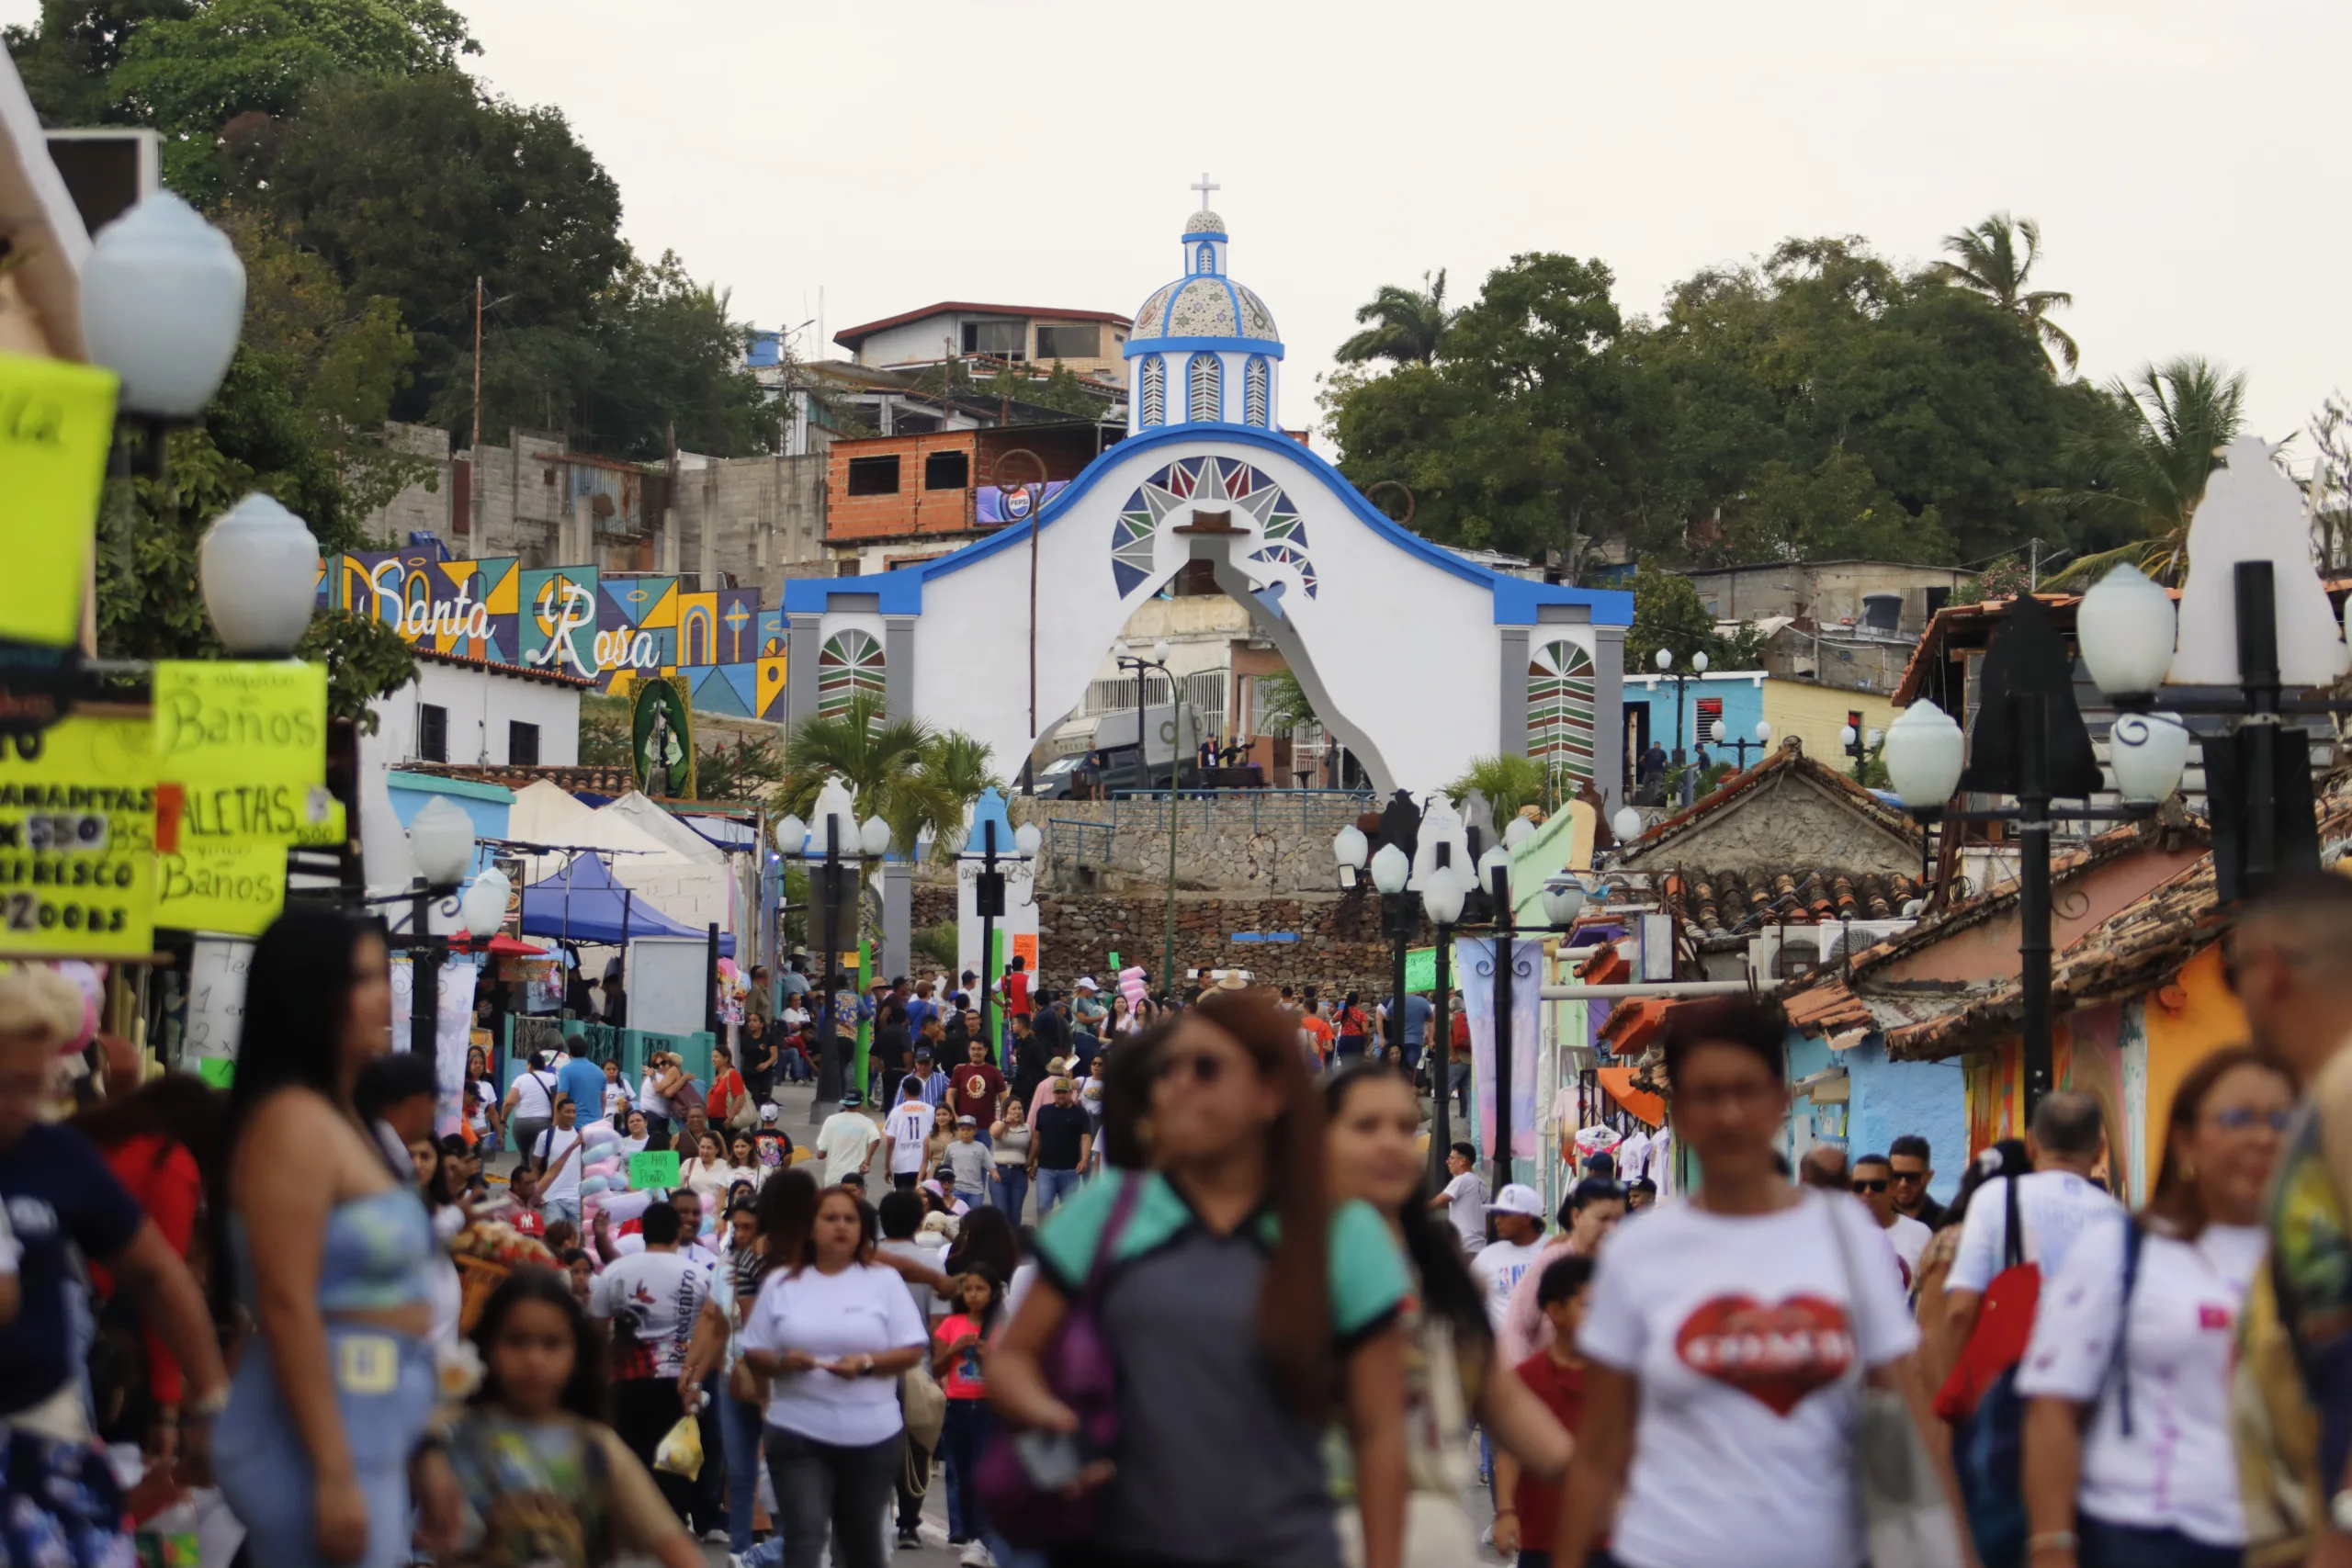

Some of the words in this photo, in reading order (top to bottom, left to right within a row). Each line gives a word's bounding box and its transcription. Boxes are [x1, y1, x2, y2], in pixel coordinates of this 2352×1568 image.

[359, 558, 496, 640] Santa
[537, 582, 661, 679] Rosa
[908, 1116, 920, 1140] 11
